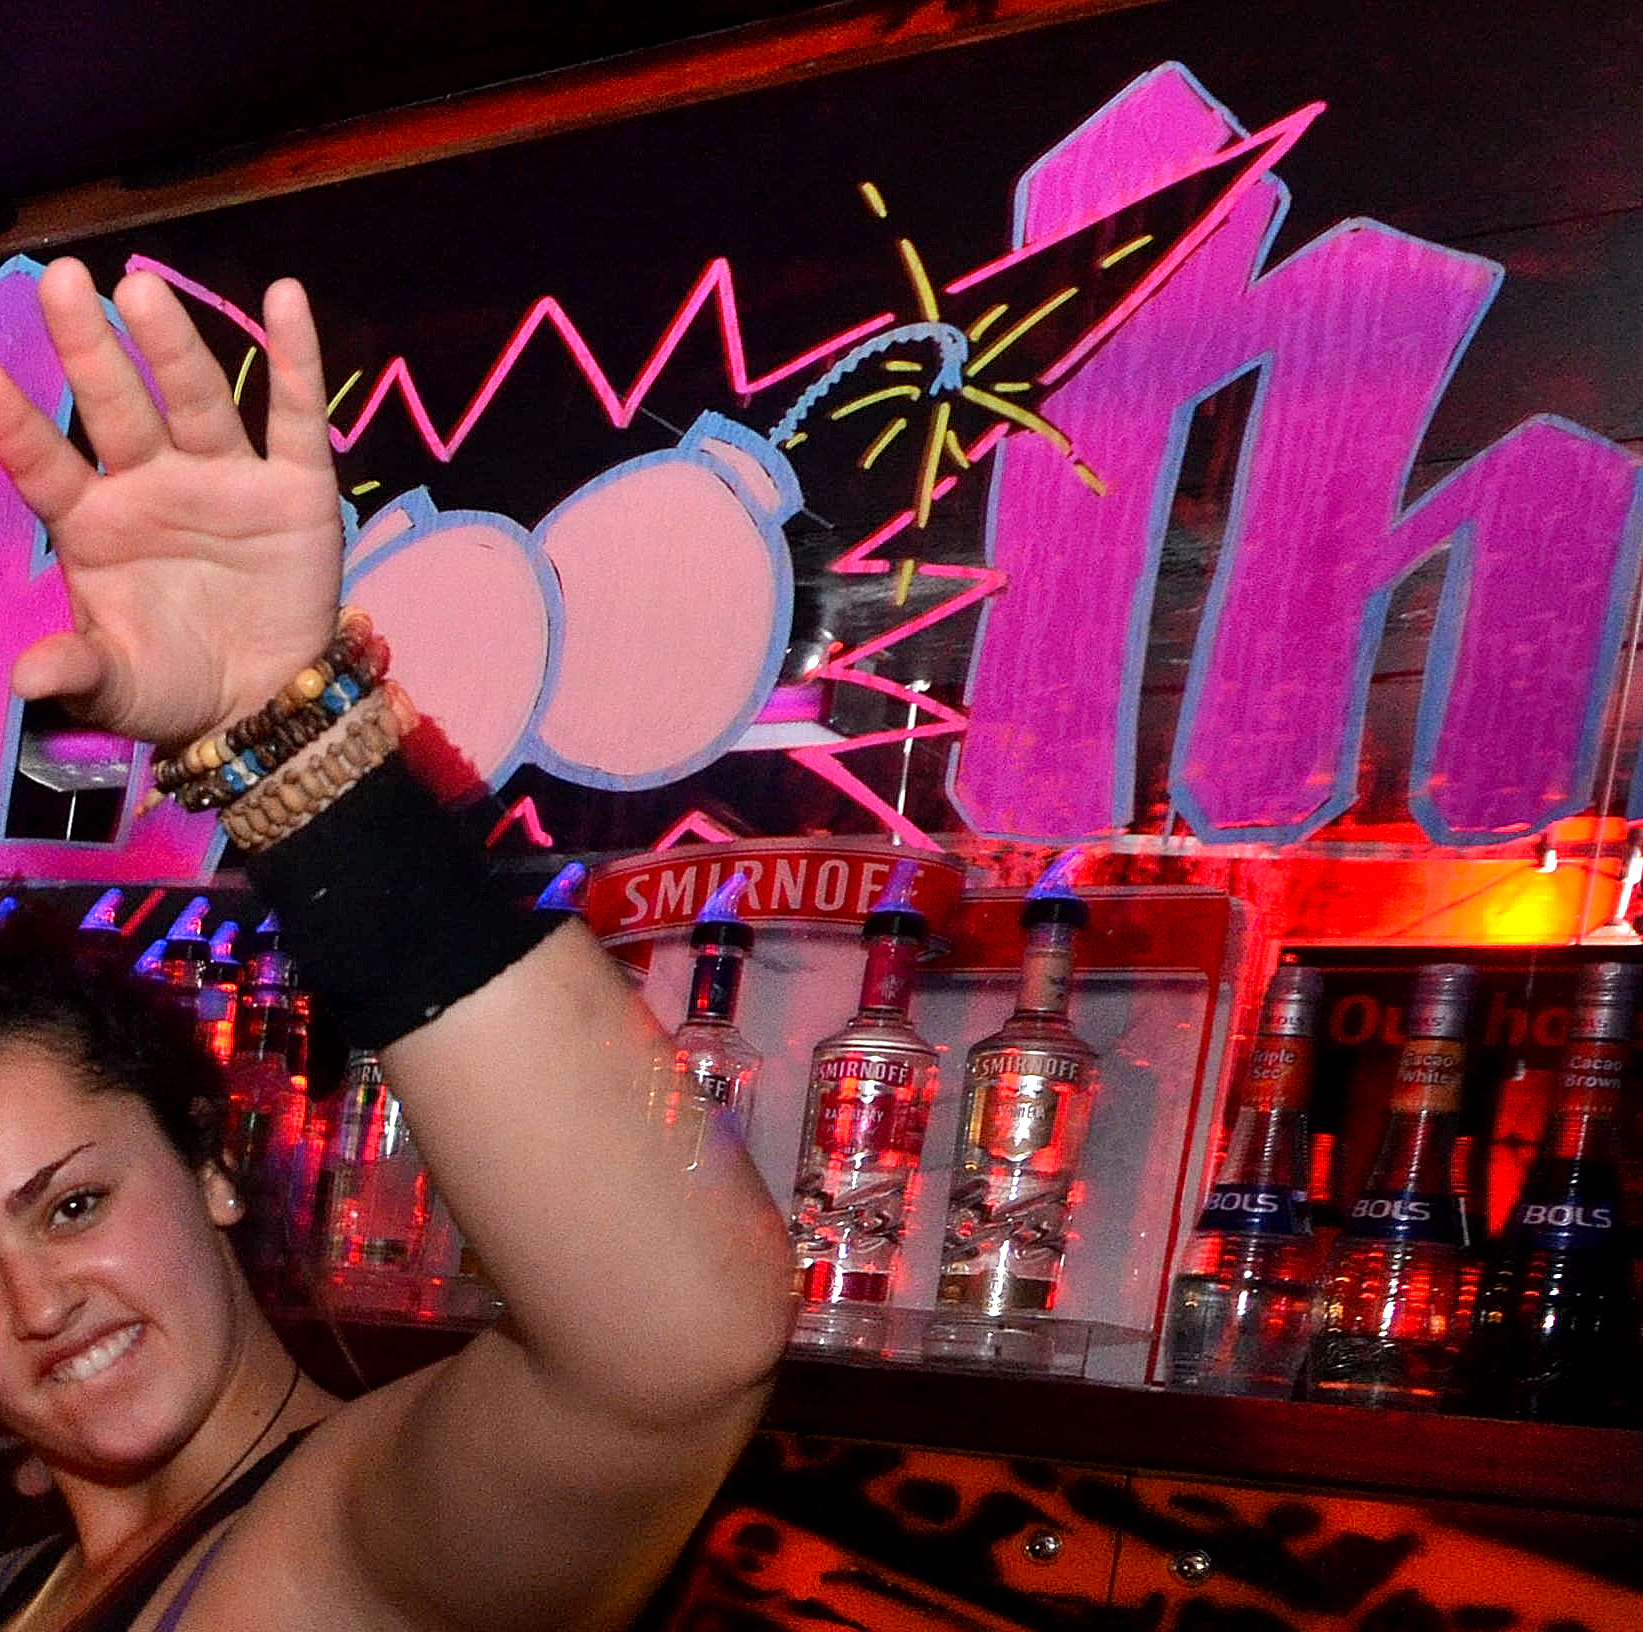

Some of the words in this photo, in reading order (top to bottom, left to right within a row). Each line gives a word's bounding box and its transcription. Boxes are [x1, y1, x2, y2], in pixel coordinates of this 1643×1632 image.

[819, 1057, 910, 1085] SMIRNOFF
[981, 1055, 1079, 1081] SMIRNOFF
[1203, 1191, 1280, 1214] BOLS
[1351, 1200, 1432, 1222] BOLS
[1522, 1203, 1613, 1229] BOLS
